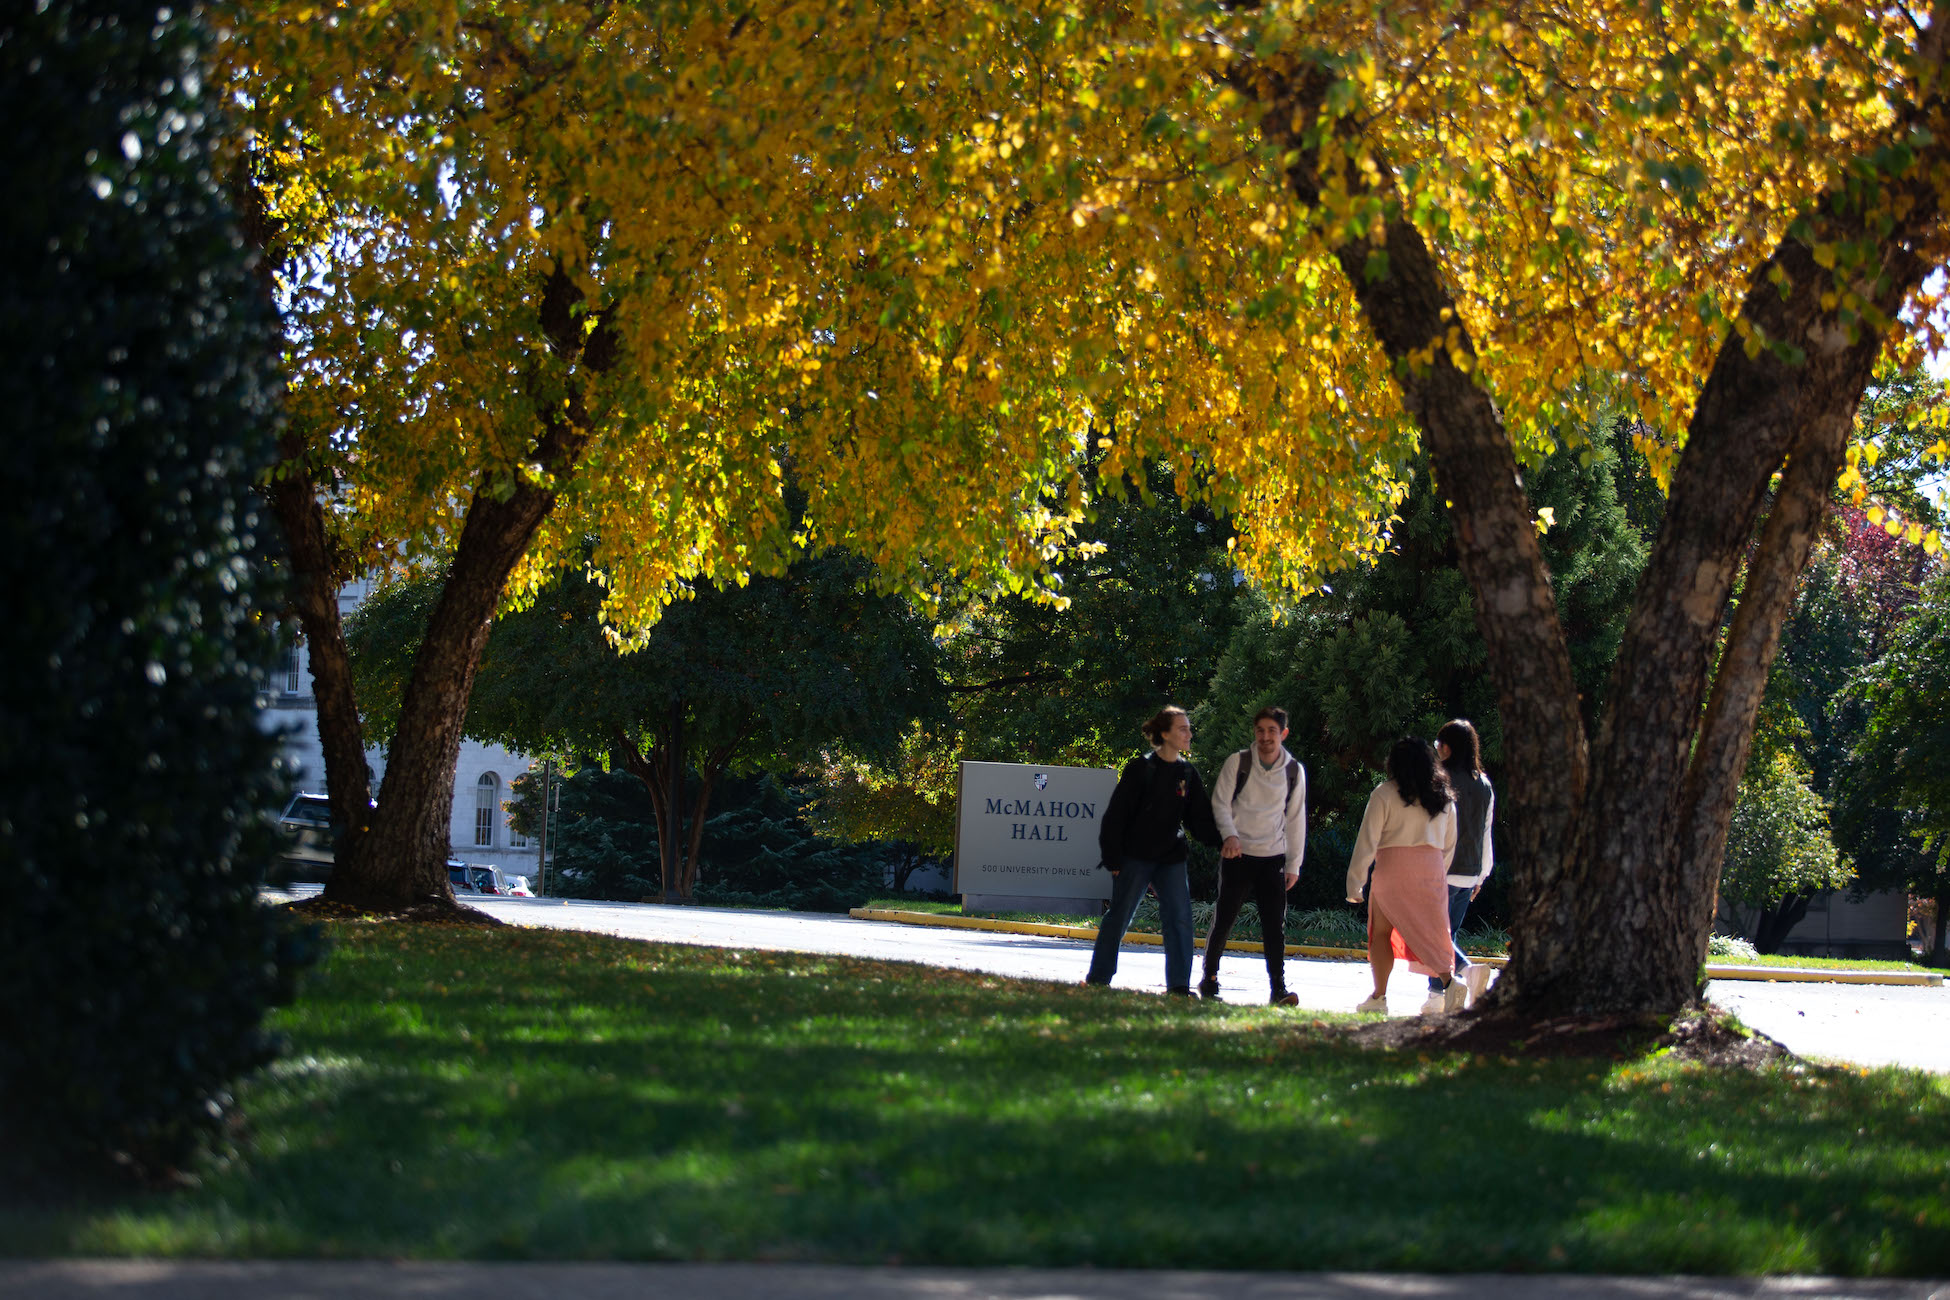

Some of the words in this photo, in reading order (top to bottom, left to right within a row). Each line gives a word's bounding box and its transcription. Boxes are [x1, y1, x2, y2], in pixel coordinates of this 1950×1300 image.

[985, 798, 1096, 819] McMAHON
[1011, 823, 1068, 842] HALL
[982, 865, 998, 873] 500
[1000, 865, 1050, 875] UNIVERSITY
[1051, 867, 1077, 875] DRIVE
